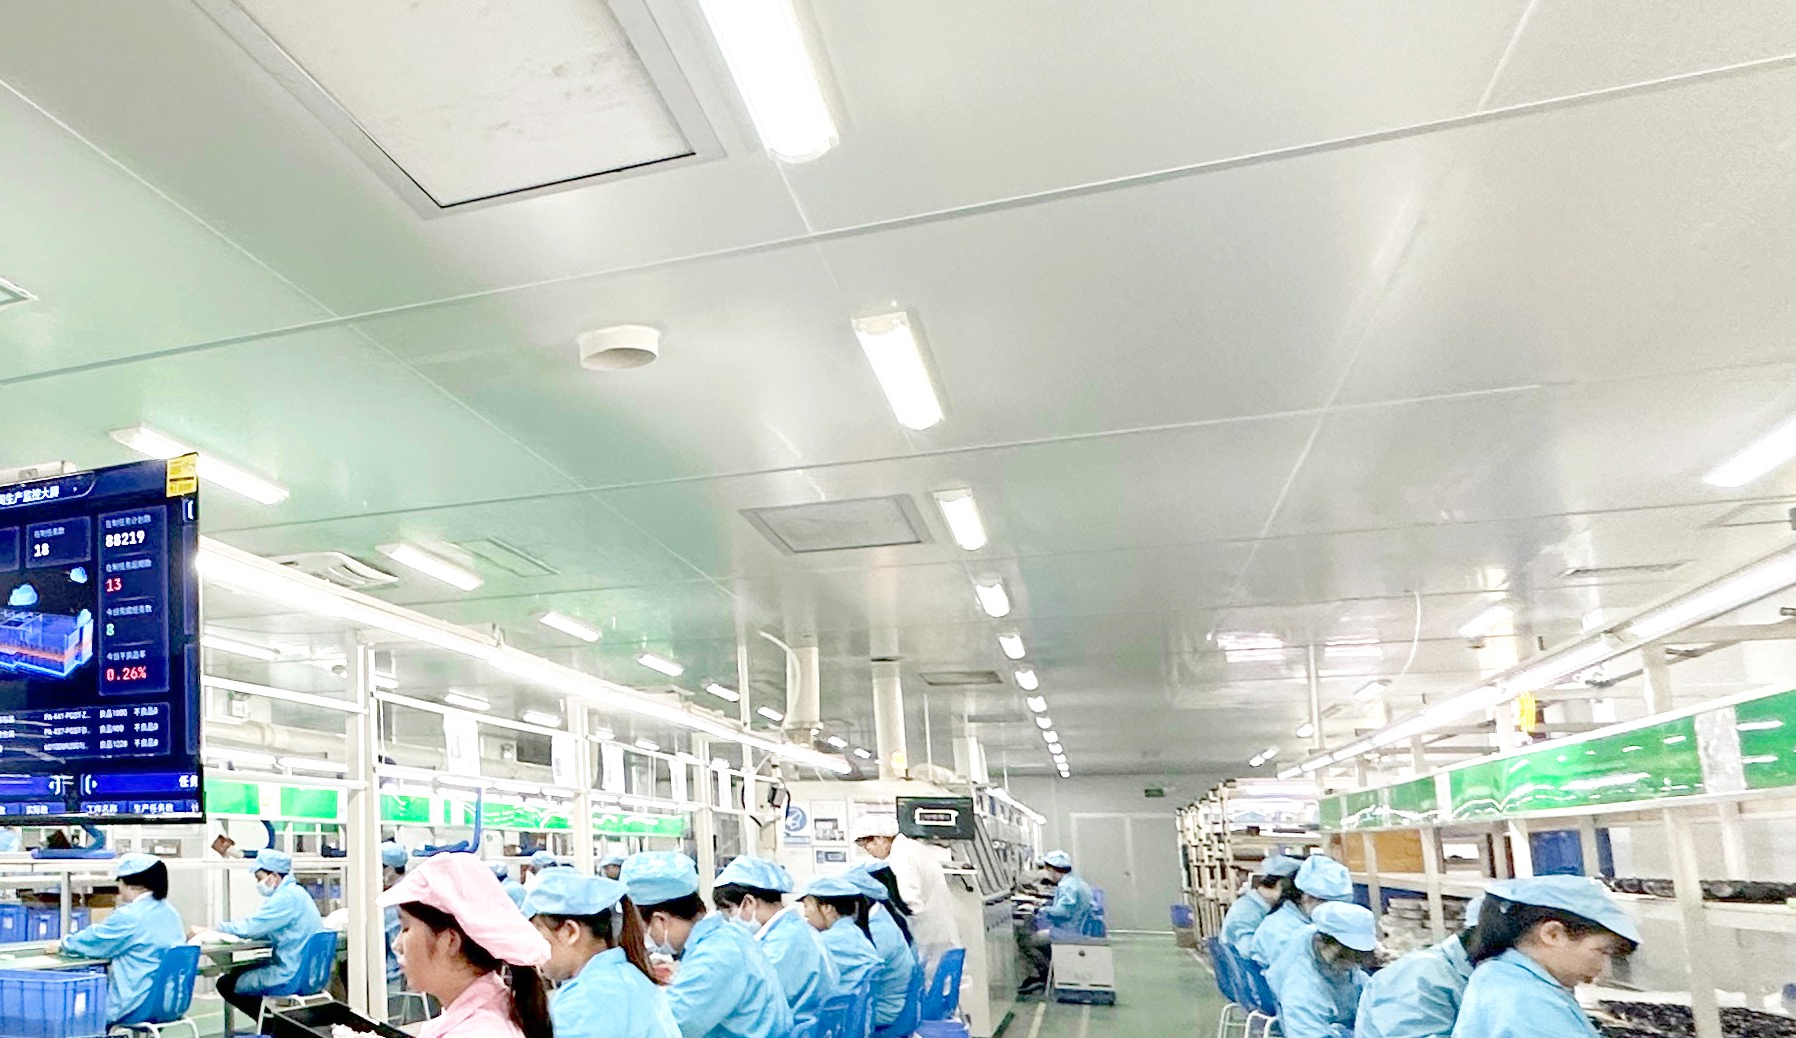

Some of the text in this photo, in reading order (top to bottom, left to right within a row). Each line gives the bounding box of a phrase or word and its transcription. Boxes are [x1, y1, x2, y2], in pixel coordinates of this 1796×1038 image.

[105, 529, 145, 548] 88219
[33, 543, 50, 558] 18
[106, 577, 122, 592] 13
[106, 622, 115, 636] 8
[106, 665, 147, 682] 0.26%
